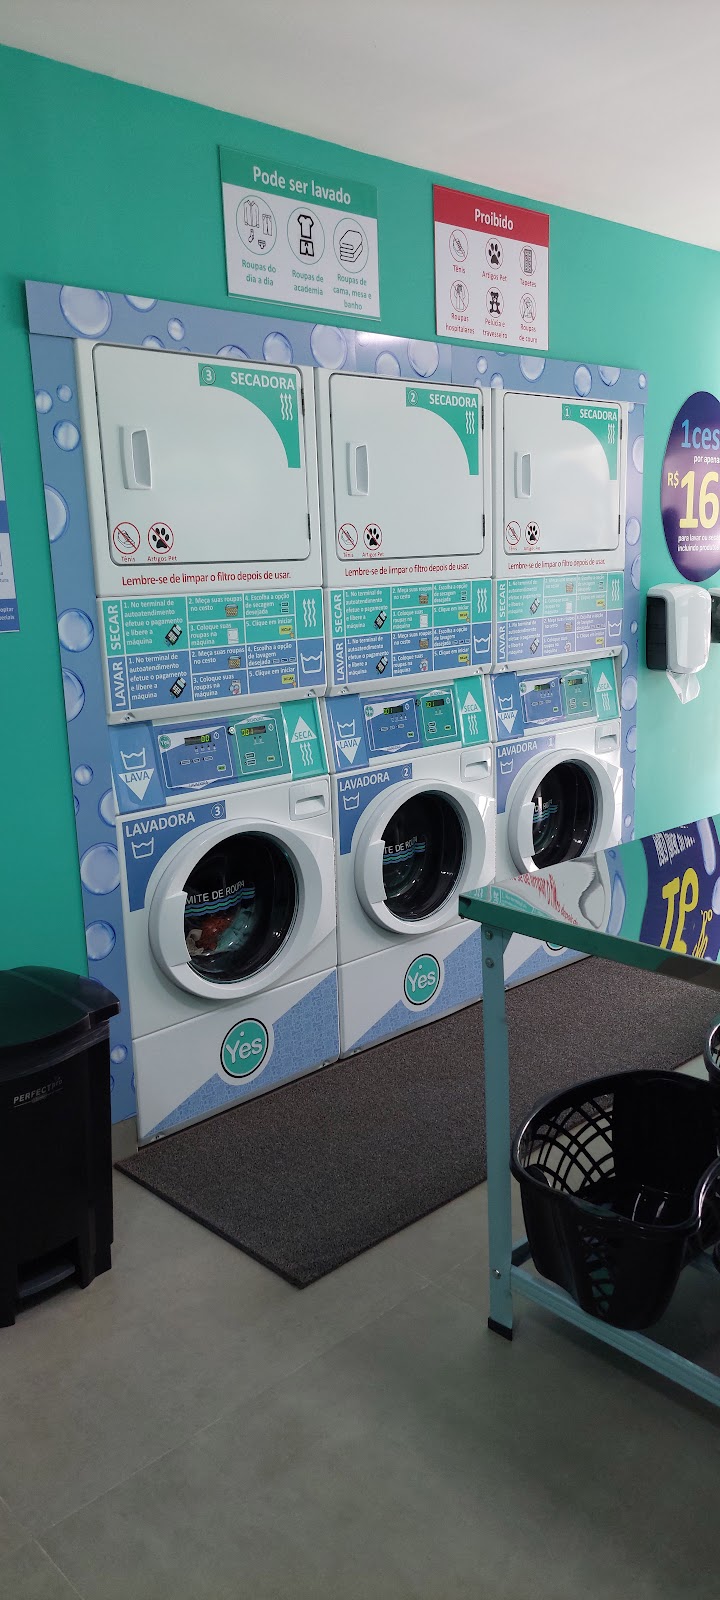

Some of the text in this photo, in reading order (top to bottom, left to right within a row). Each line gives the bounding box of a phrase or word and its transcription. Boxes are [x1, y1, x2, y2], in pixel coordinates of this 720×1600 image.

[253, 166, 350, 205] Pode ser lavado
[474, 208, 514, 230] Proibido
[242, 260, 276, 273] Roupas do
[452, 264, 466, 274] Tênis
[246, 273, 256, 283] dia
[264, 276, 274, 286] dia
[292, 270, 324, 282] Roupas de
[337, 273, 366, 286] Roupas de
[482, 270, 498, 280] Artigos
[294, 283, 324, 296] academia
[332, 286, 350, 296] cama,
[352, 290, 366, 299] mesa
[344, 299, 362, 310] banho
[206, 370, 296, 390] 3 SECADORA
[410, 393, 478, 408] 2 SECADORA
[565, 408, 618, 422] 1 SECADORA
[694, 456, 703, 464] por
[668, 470, 720, 528] R$ 16
[345, 566, 378, 577] Lembre-se
[380, 566, 388, 575] de
[388, 565, 408, 576] limpar
[414, 564, 428, 572] filtro
[429, 562, 448, 574] depois
[448, 562, 456, 570] de
[122, 572, 168, 586] Lembre-se
[170, 573, 180, 584] de
[182, 572, 208, 585] limpar
[217, 571, 236, 582] filtro
[237, 571, 262, 583] depois
[263, 570, 274, 580] de
[274, 571, 291, 580] usar.
[141, 599, 166, 607] terminal
[124, 609, 176, 618] autoatendimento
[334, 593, 342, 633] SECAR
[108, 604, 121, 650] SECAR
[125, 620, 145, 628] efetue
[151, 618, 183, 628] pagamento
[196, 624, 219, 632] Coloque
[126, 637, 153, 646] máquina
[190, 632, 210, 640] roupas
[146, 654, 170, 664] terminal
[336, 642, 345, 681] LAVAR
[130, 663, 180, 674] autoatendimento
[130, 674, 150, 682] efetue
[156, 672, 188, 682] pagamento
[200, 676, 222, 684] Coloque
[112, 661, 126, 707] LAVAR
[194, 684, 212, 692] roupas
[132, 692, 158, 702] máquina
[195, 690, 218, 698] máquina
[464, 704, 479, 712] SECA
[295, 731, 314, 740] SECA
[339, 739, 358, 749] LAVA
[498, 738, 554, 758] LAVADORA 1
[124, 771, 150, 783] LAVA
[339, 768, 409, 792] LAVADORA 2
[126, 806, 221, 838] LAVADORA 3
[395, 842, 404, 852] DE
[212, 889, 224, 900] DE
[408, 965, 436, 992] Yes
[226, 1031, 263, 1064] Yes
